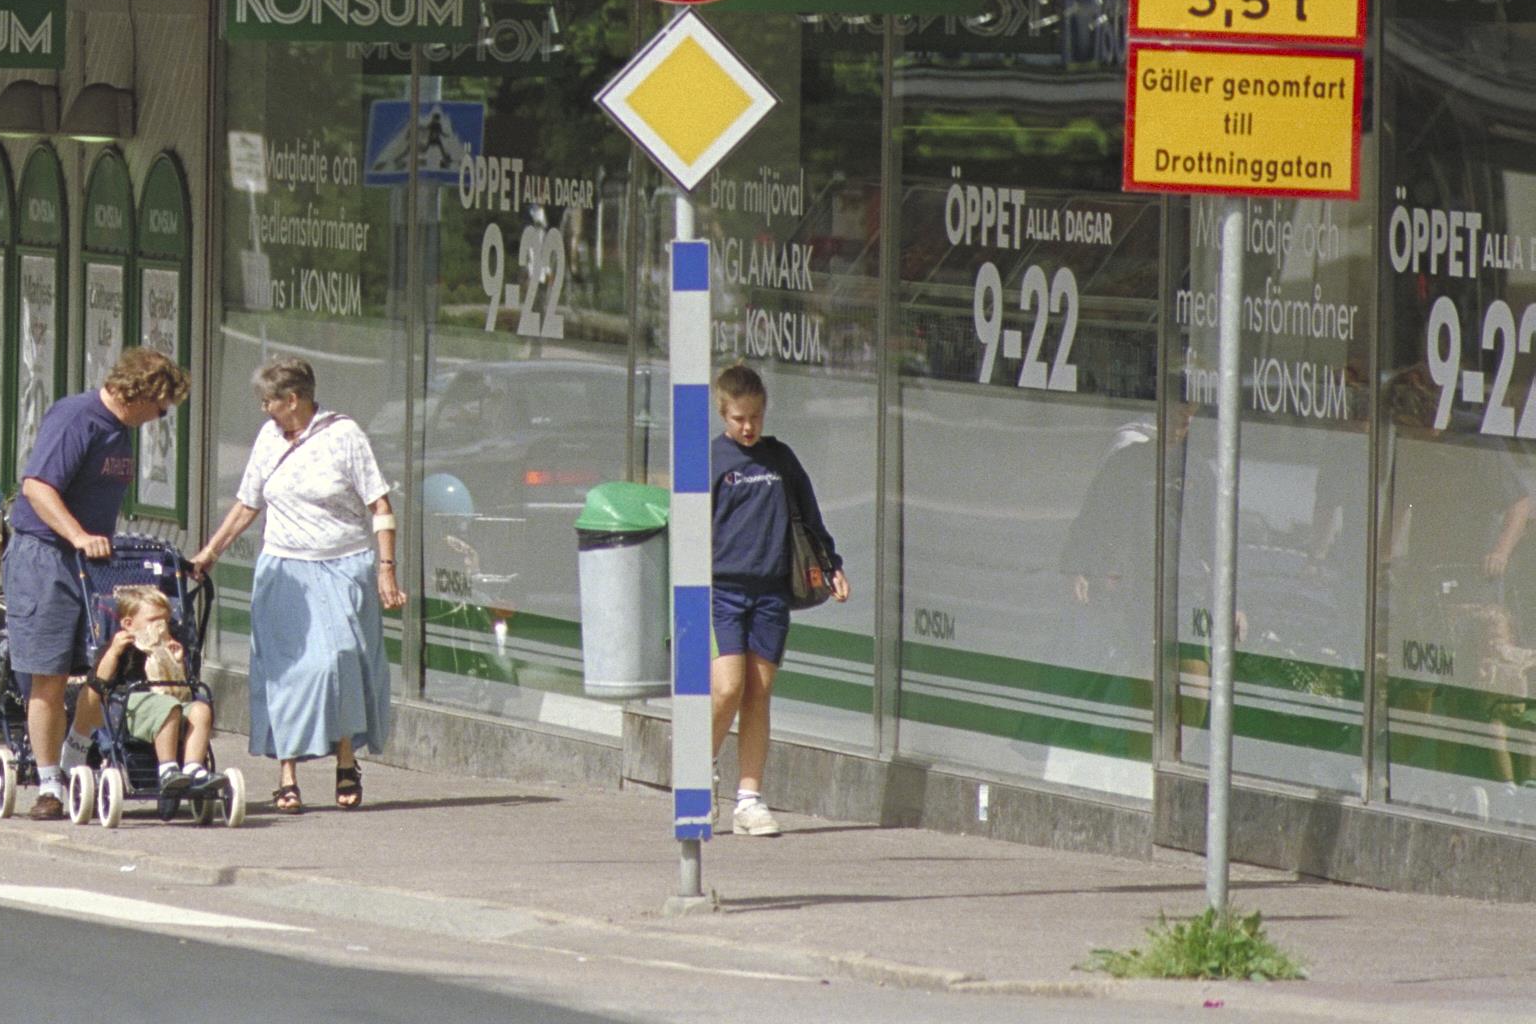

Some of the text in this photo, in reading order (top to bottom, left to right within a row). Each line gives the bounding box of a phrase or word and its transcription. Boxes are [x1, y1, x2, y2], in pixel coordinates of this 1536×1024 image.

[1142, 68, 1346, 101] Gäller genomfart
[1224, 112, 1252, 136] till
[333, 142, 357, 185] och
[459, 142, 594, 212] ÖPPET ALLA DAGAR
[1155, 148, 1332, 182] Drottninggatan
[710, 167, 804, 226] Bra miljöval
[945, 166, 1112, 250] ÖPPET ALLA DAGAR
[1303, 202, 1339, 261] och
[1389, 186, 1482, 278] ÖPPET
[1483, 232, 1524, 271] ALLA
[481, 223, 564, 339] 9-22
[711, 237, 814, 291] NGLAMARK
[291, 267, 296, 309] i
[300, 268, 362, 317] KONSUM
[745, 308, 822, 362] KONSUM
[974, 262, 1078, 392] 9-22
[1253, 357, 1348, 420] KONSUM
[915, 608, 955, 641] KONSUM
[1402, 639, 1454, 676] KONSUM
